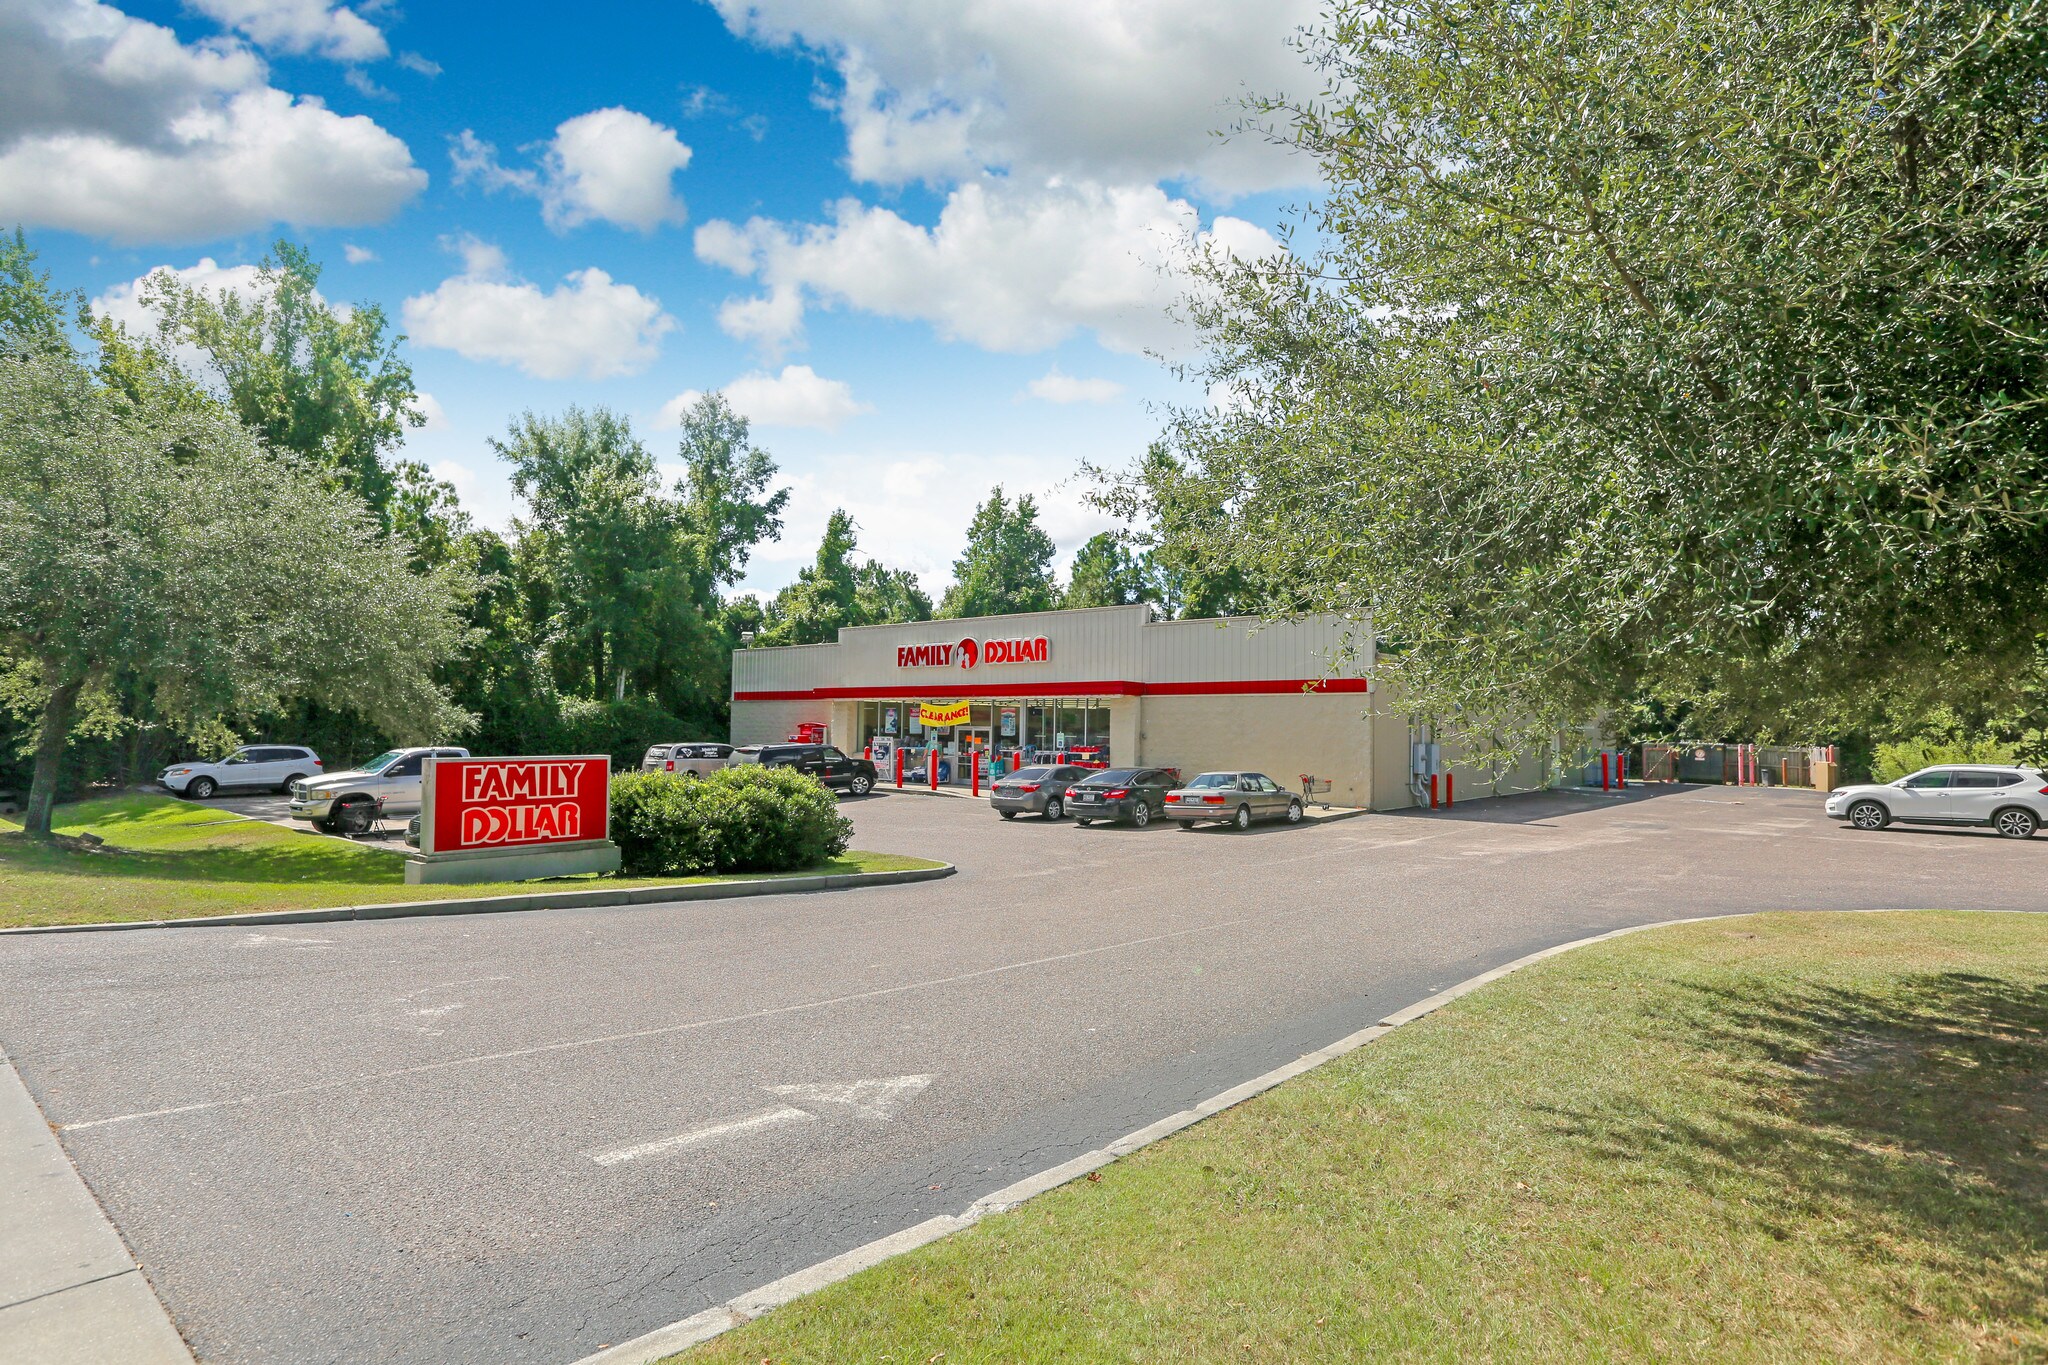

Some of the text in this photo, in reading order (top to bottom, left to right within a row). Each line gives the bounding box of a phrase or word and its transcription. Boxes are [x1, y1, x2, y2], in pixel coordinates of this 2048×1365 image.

[897, 637, 1048, 667] FAMILY DOLLAR
[462, 763, 586, 802] FAMILY
[461, 802, 580, 845] DOLLAR
